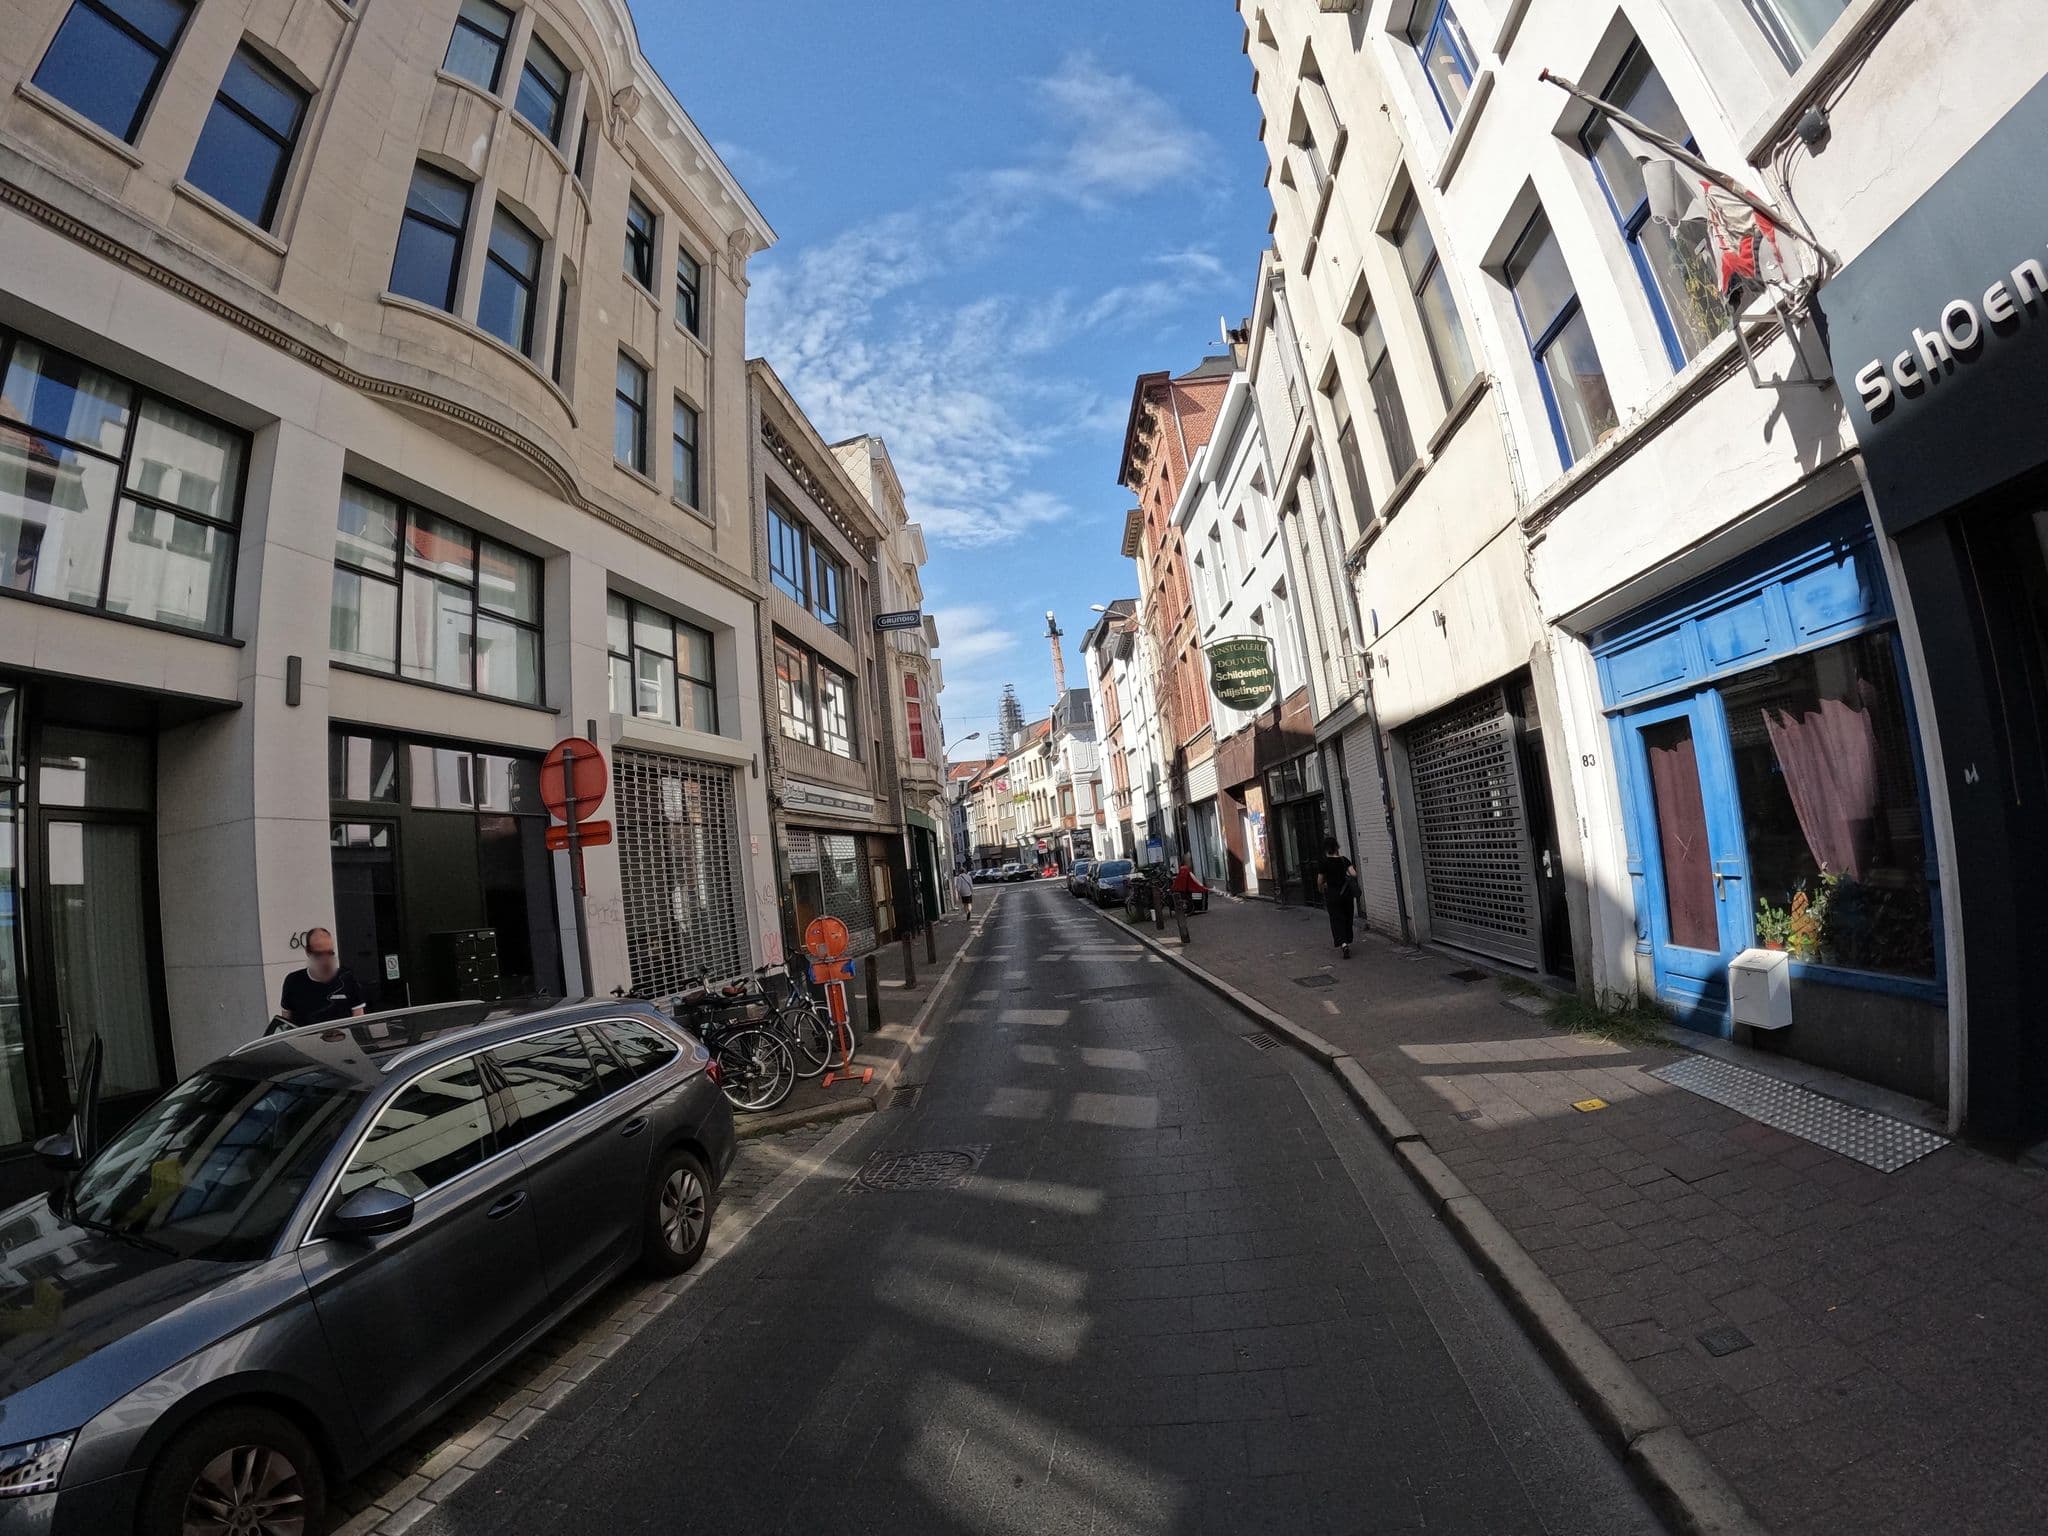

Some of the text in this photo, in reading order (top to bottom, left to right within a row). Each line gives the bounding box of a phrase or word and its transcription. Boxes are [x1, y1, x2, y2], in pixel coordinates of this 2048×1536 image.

[1854, 246, 2048, 413] SchOen
[881, 615, 915, 625] GRUNDIG
[1215, 667, 1268, 682] Schilderijen
[1217, 684, 1272, 698] Inlijstingen
[1582, 753, 1596, 767] 83
